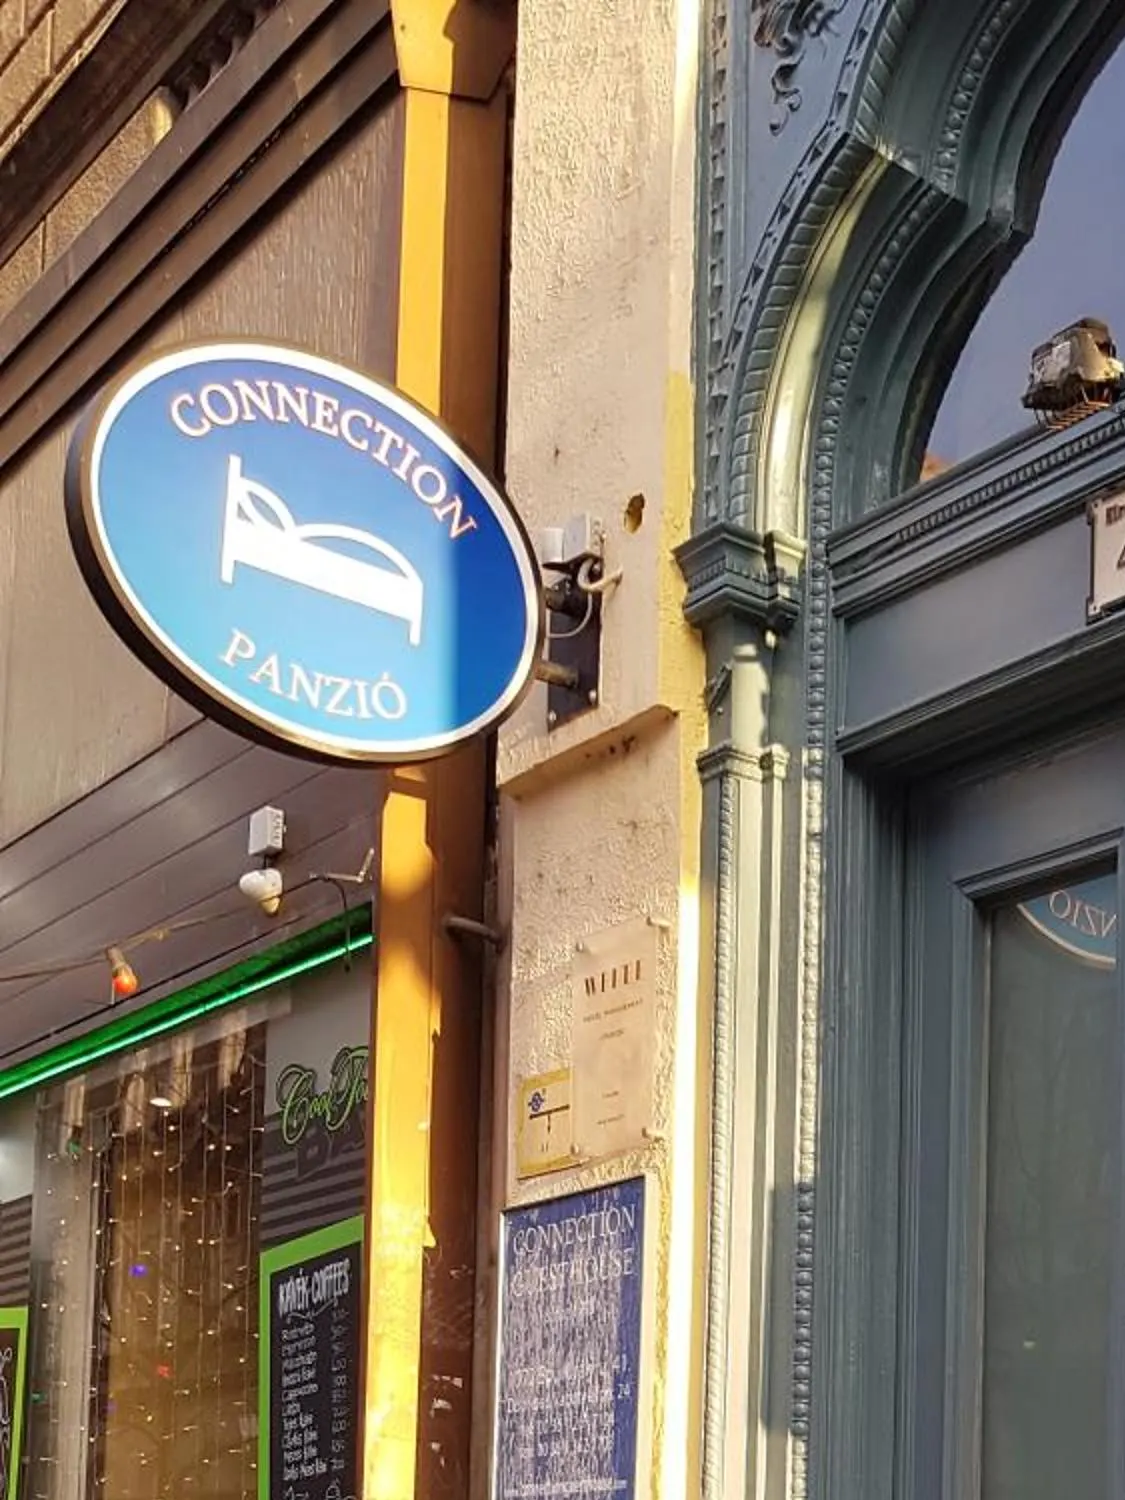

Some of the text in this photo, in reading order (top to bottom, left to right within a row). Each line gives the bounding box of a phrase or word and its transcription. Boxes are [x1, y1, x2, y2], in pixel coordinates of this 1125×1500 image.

[170, 378, 478, 541] CONNECTION
[220, 627, 408, 720] PANZIÓ
[513, 1203, 637, 1256] CONNECTION
